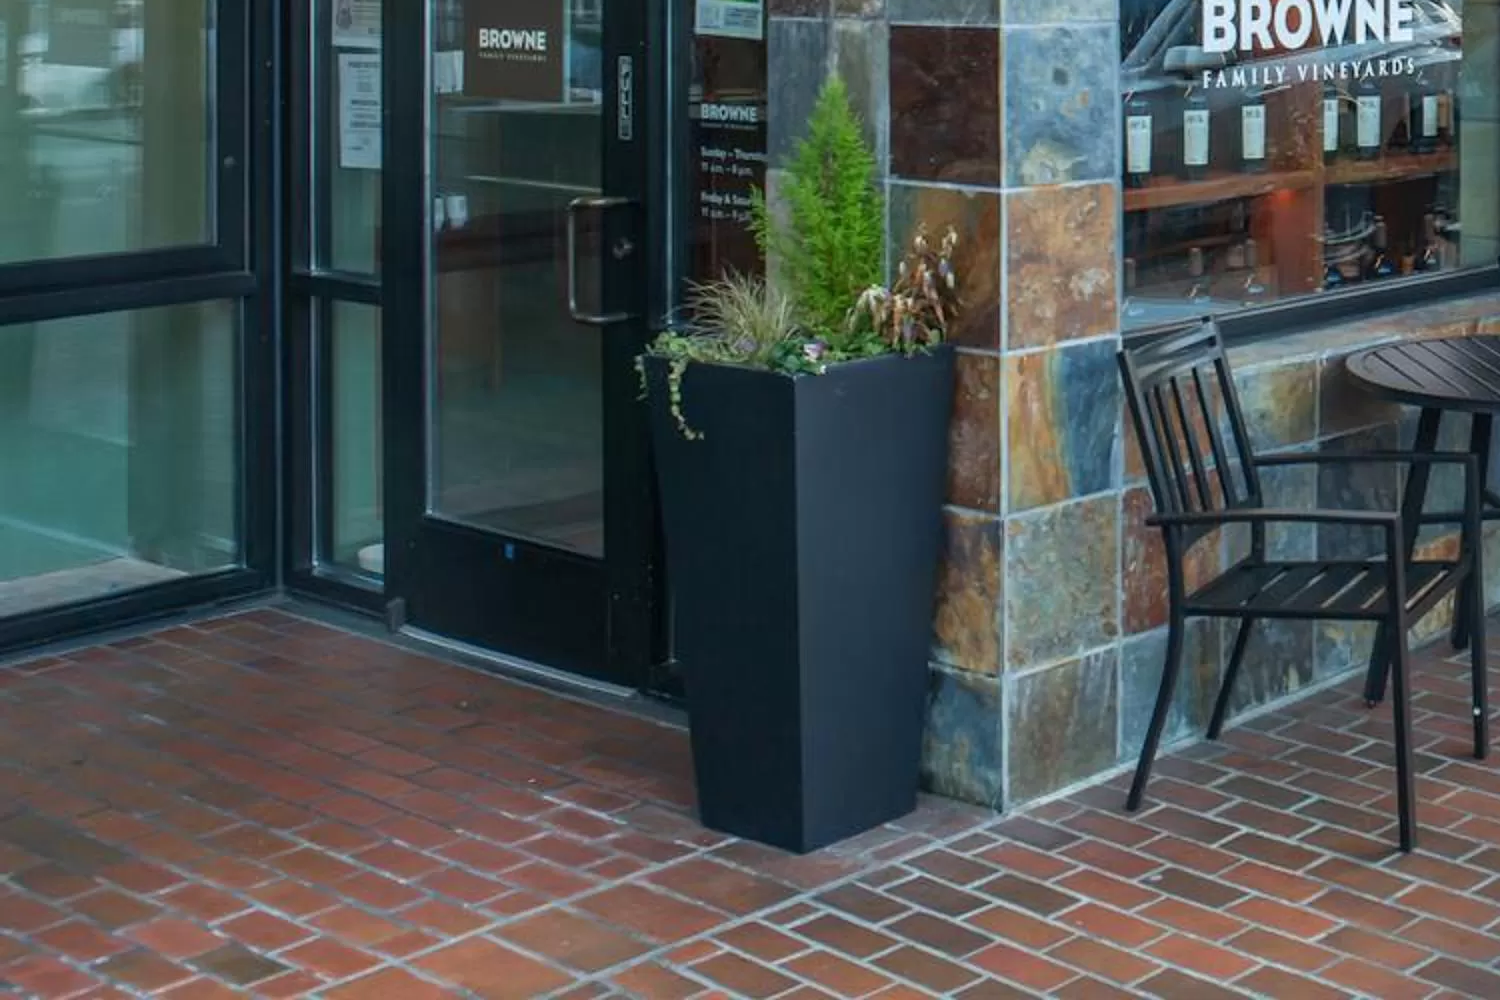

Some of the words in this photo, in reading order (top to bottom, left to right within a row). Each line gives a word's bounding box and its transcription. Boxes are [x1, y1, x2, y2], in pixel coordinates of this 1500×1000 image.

[479, 27, 547, 51] BROWNE
[1203, 66, 1285, 89] FAMILY
[1297, 56, 1415, 82] VINEYARDS
[700, 103, 758, 123] BROWNE
